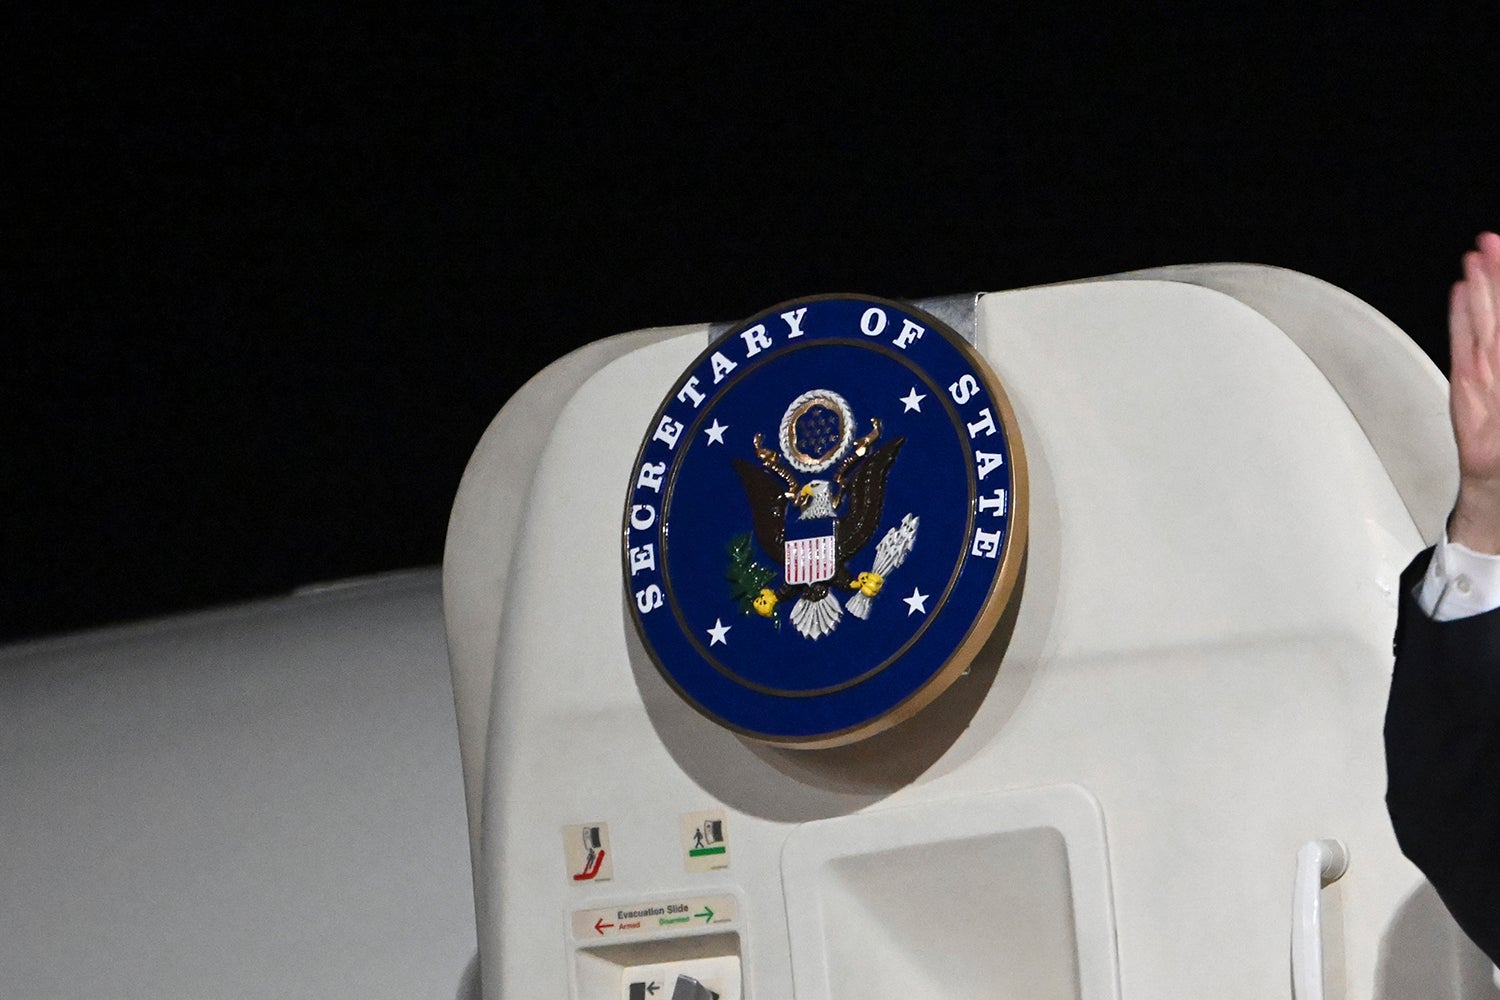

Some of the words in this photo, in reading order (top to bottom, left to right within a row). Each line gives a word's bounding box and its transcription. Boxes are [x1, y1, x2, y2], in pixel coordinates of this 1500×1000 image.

[629, 307, 808, 615] SECRETARY
[860, 306, 926, 350] OF
[948, 373, 1006, 560] STATE
[617, 906, 665, 920] Evacuation
[666, 904, 689, 914] Slide
[618, 921, 641, 930] Armed
[658, 916, 690, 926] Disarmed
